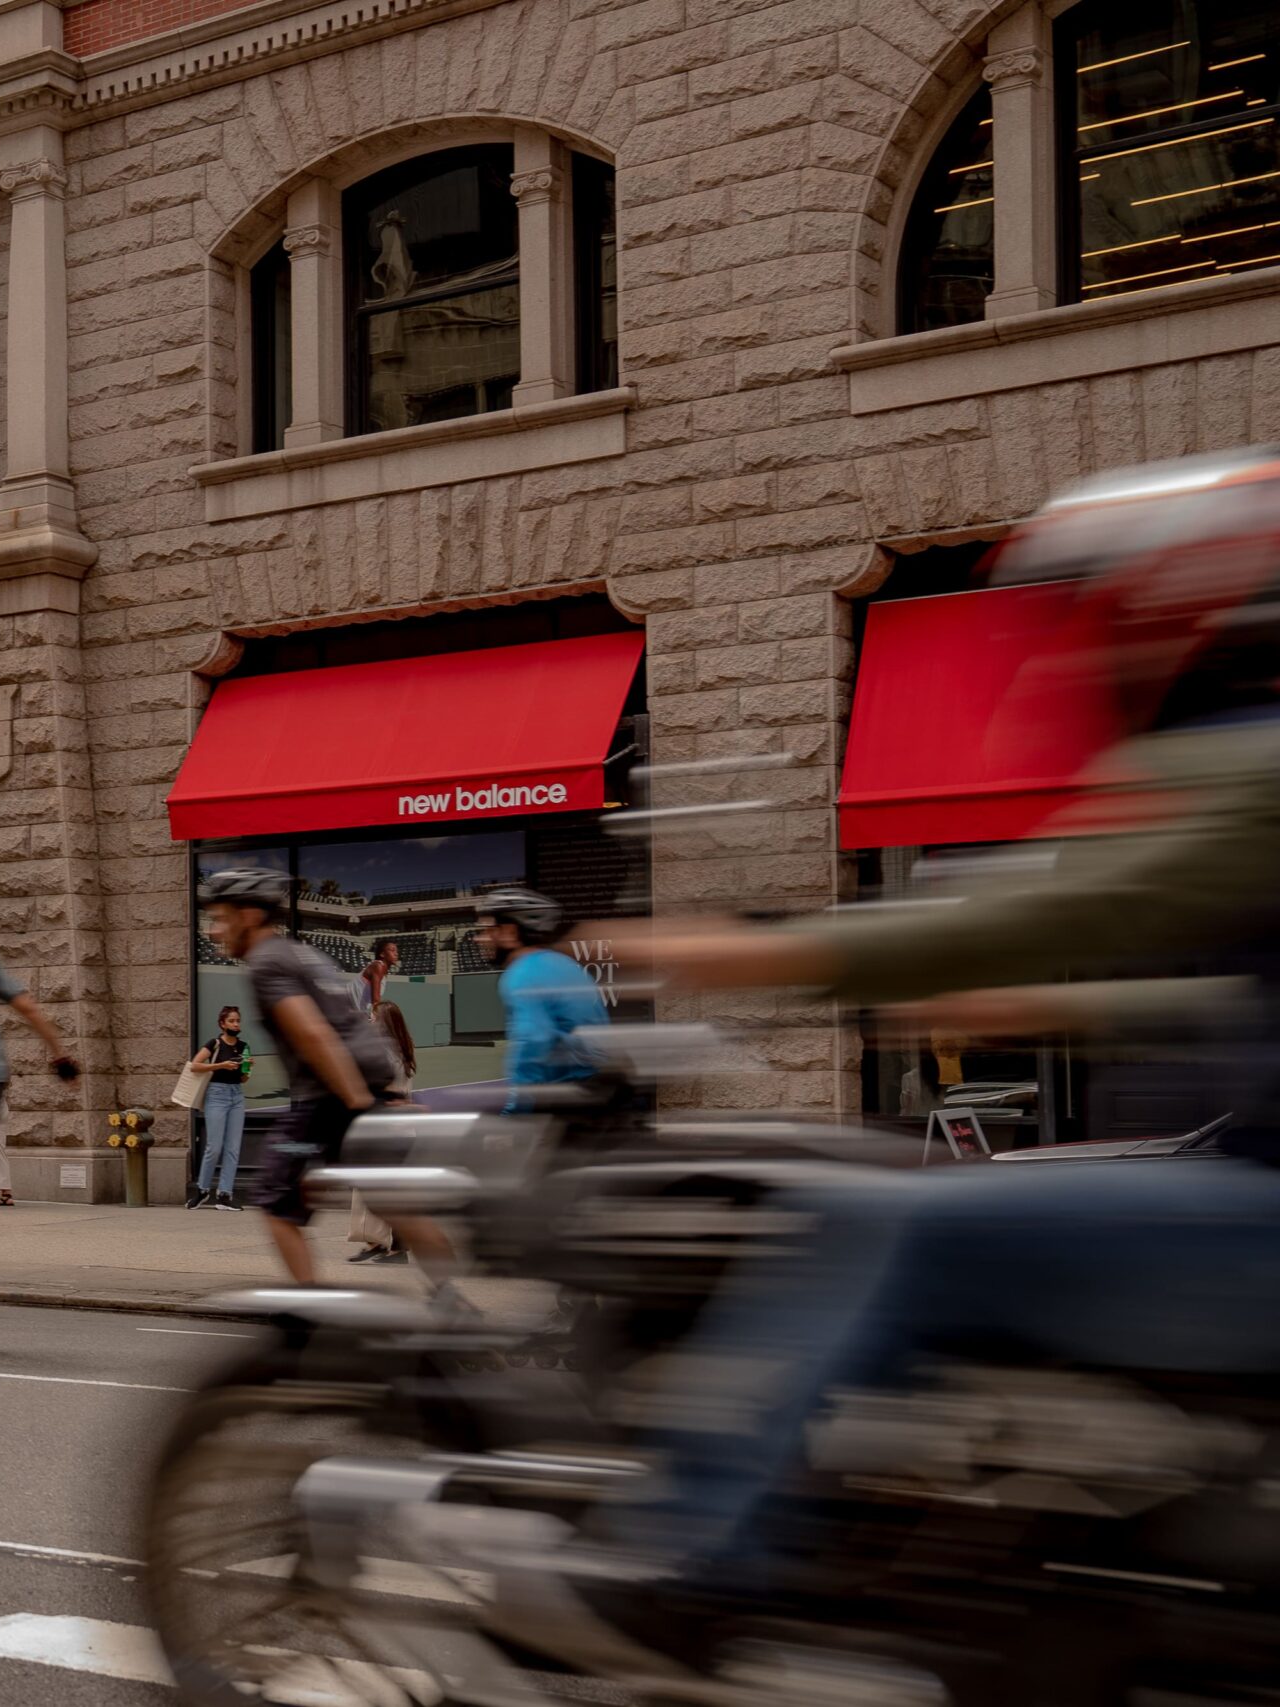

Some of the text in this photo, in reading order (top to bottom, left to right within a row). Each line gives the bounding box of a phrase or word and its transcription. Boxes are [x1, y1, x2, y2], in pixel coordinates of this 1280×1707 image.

[398, 783, 567, 815] new balance
[568, 940, 614, 961] WE
[576, 962, 620, 984] OT
